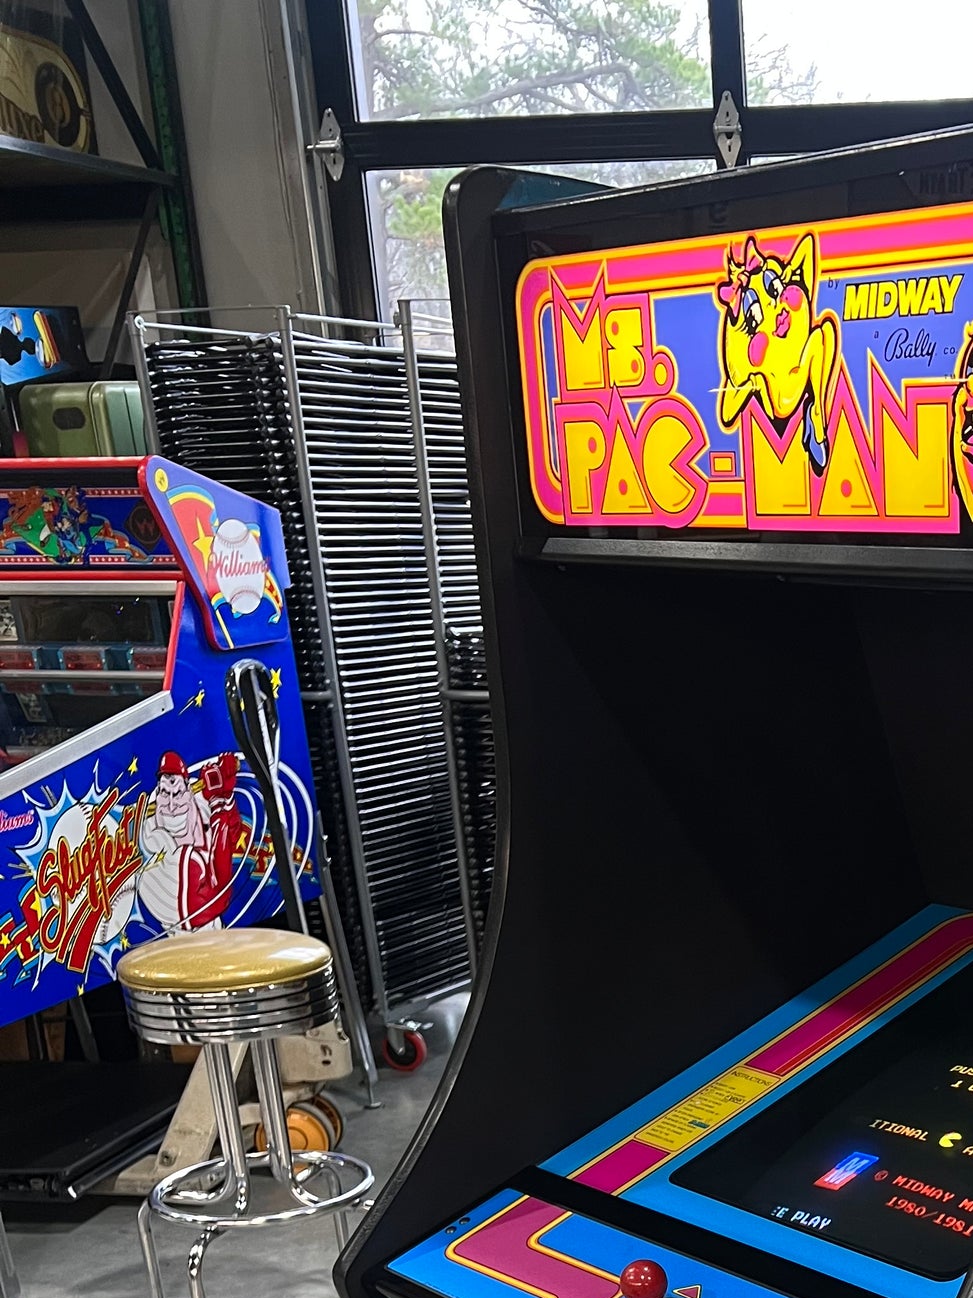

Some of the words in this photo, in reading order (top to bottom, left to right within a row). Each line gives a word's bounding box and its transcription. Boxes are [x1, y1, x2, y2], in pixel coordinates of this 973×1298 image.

[828, 278, 840, 290] by
[843, 273, 965, 322] MIDWAY
[885, 328, 937, 368] Bally
[555, 357, 957, 528] PAC-MAN
[950, 1080, 963, 1088] 1
[892, 1175, 956, 1203] MIDWAY
[790, 1210, 832, 1230] PLAY
